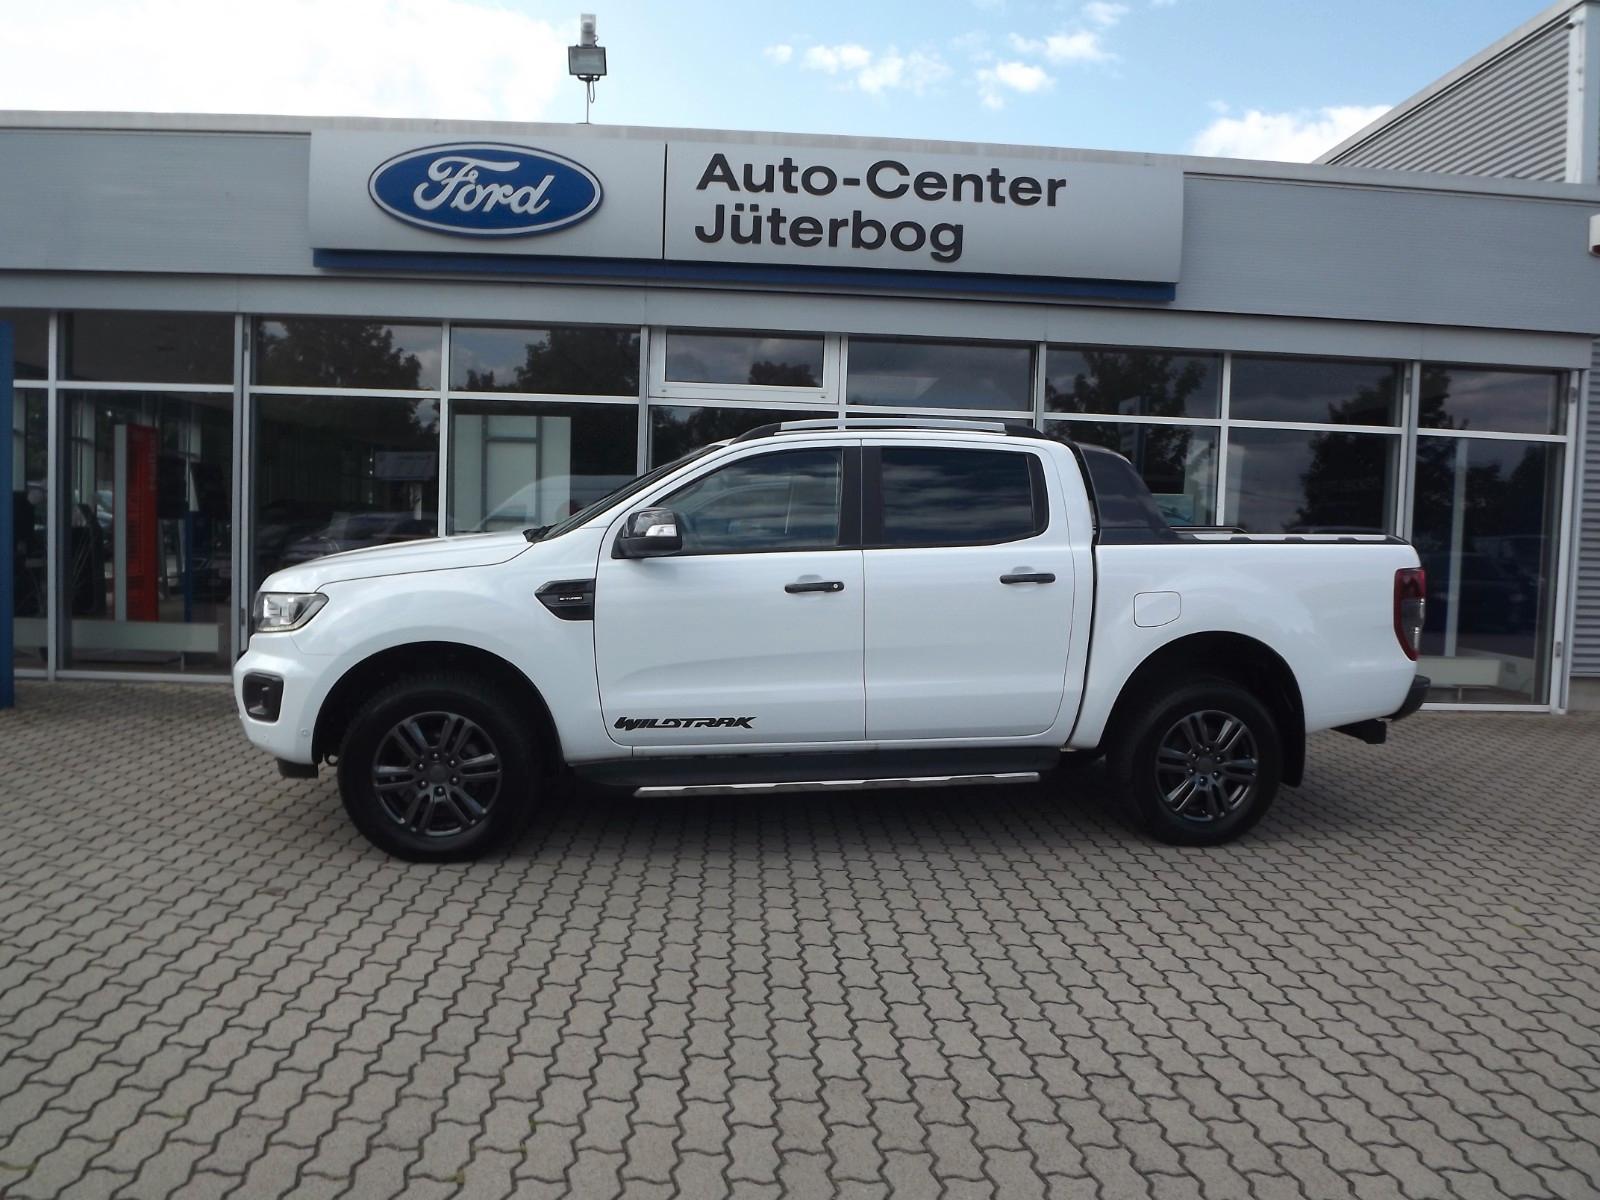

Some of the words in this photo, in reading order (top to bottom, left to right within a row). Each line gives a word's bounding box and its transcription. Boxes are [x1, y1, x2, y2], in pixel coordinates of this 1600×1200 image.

[413, 156, 555, 214] Ford
[695, 153, 1067, 207] Auto-Center
[694, 202, 964, 265] Jüterbog
[613, 716, 756, 731] WILDTRAK
